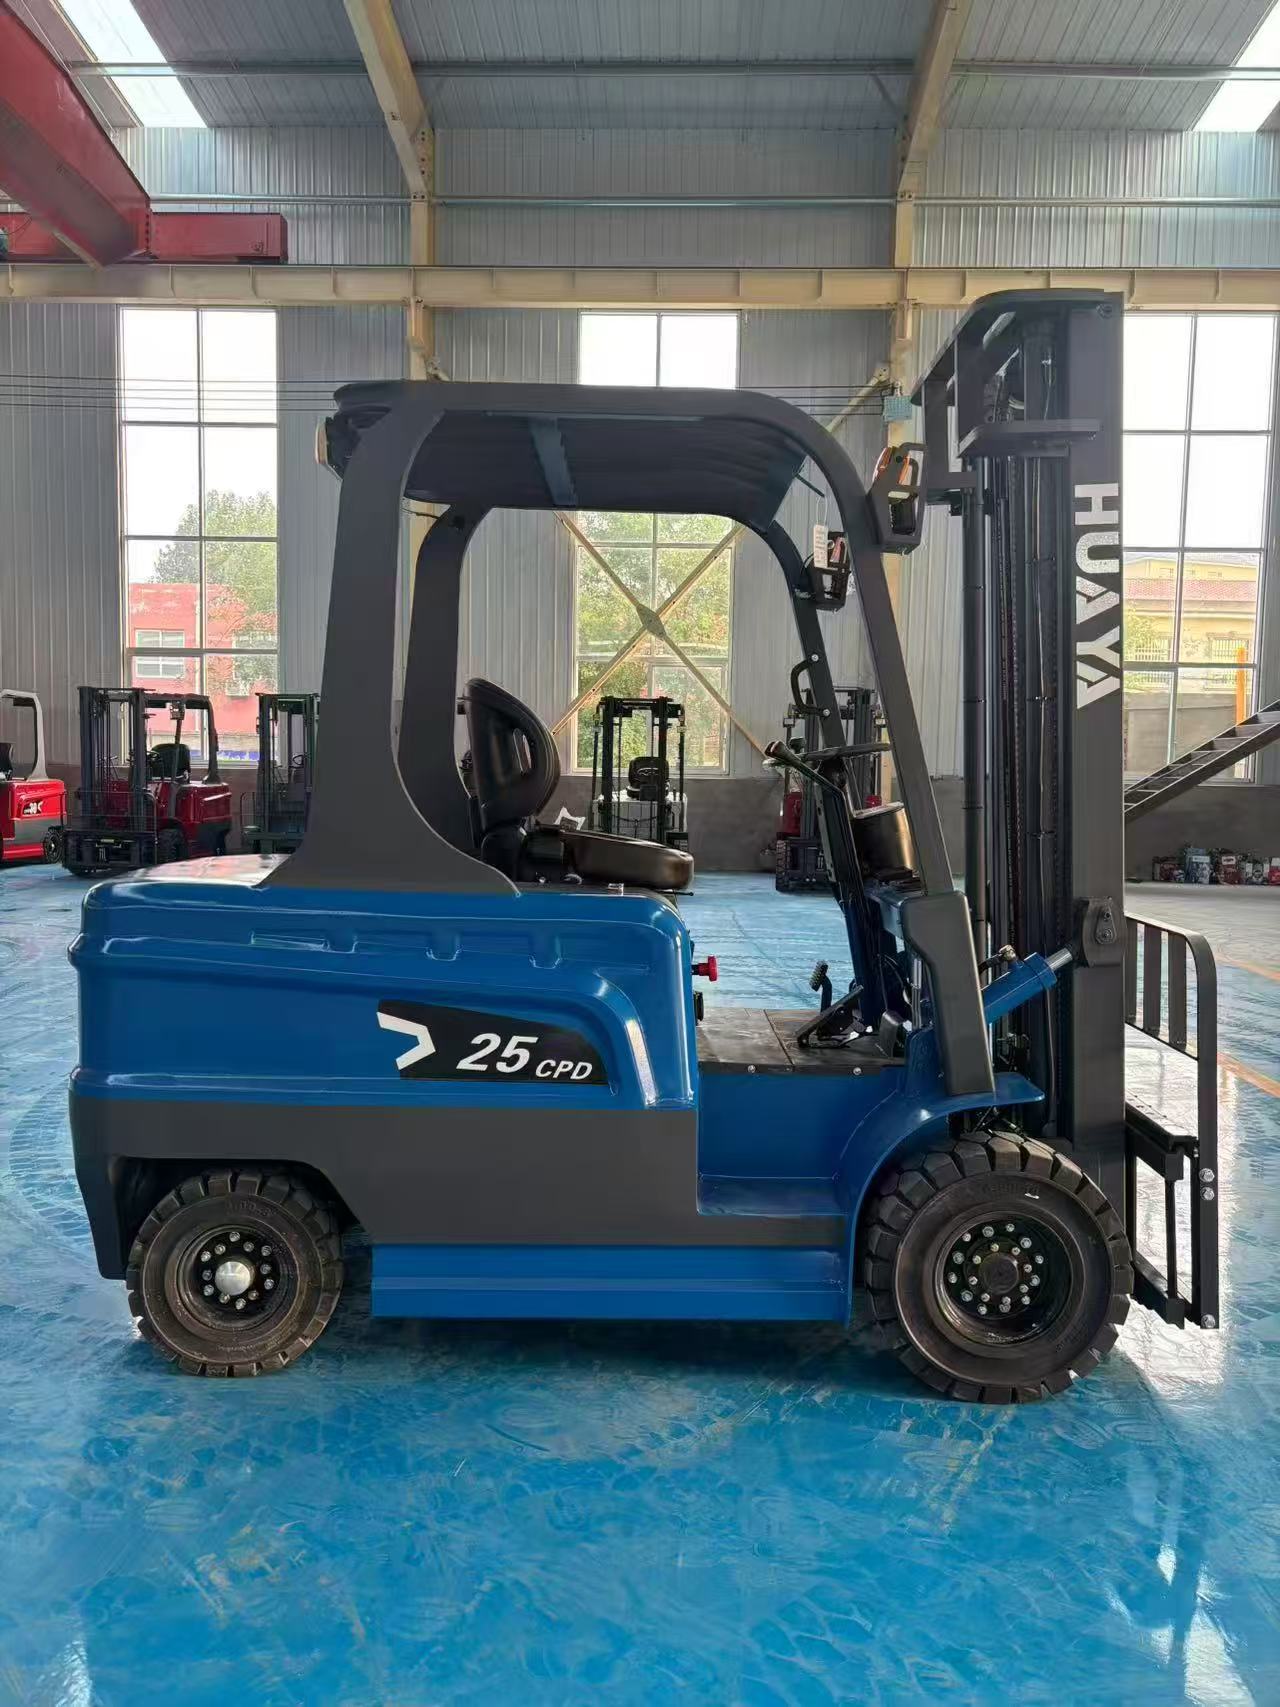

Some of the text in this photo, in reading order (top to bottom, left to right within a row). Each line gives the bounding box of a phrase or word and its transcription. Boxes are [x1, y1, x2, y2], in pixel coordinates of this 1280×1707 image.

[1074, 483, 1120, 709] HUAYA
[456, 1032, 593, 1080] 25 CPD
